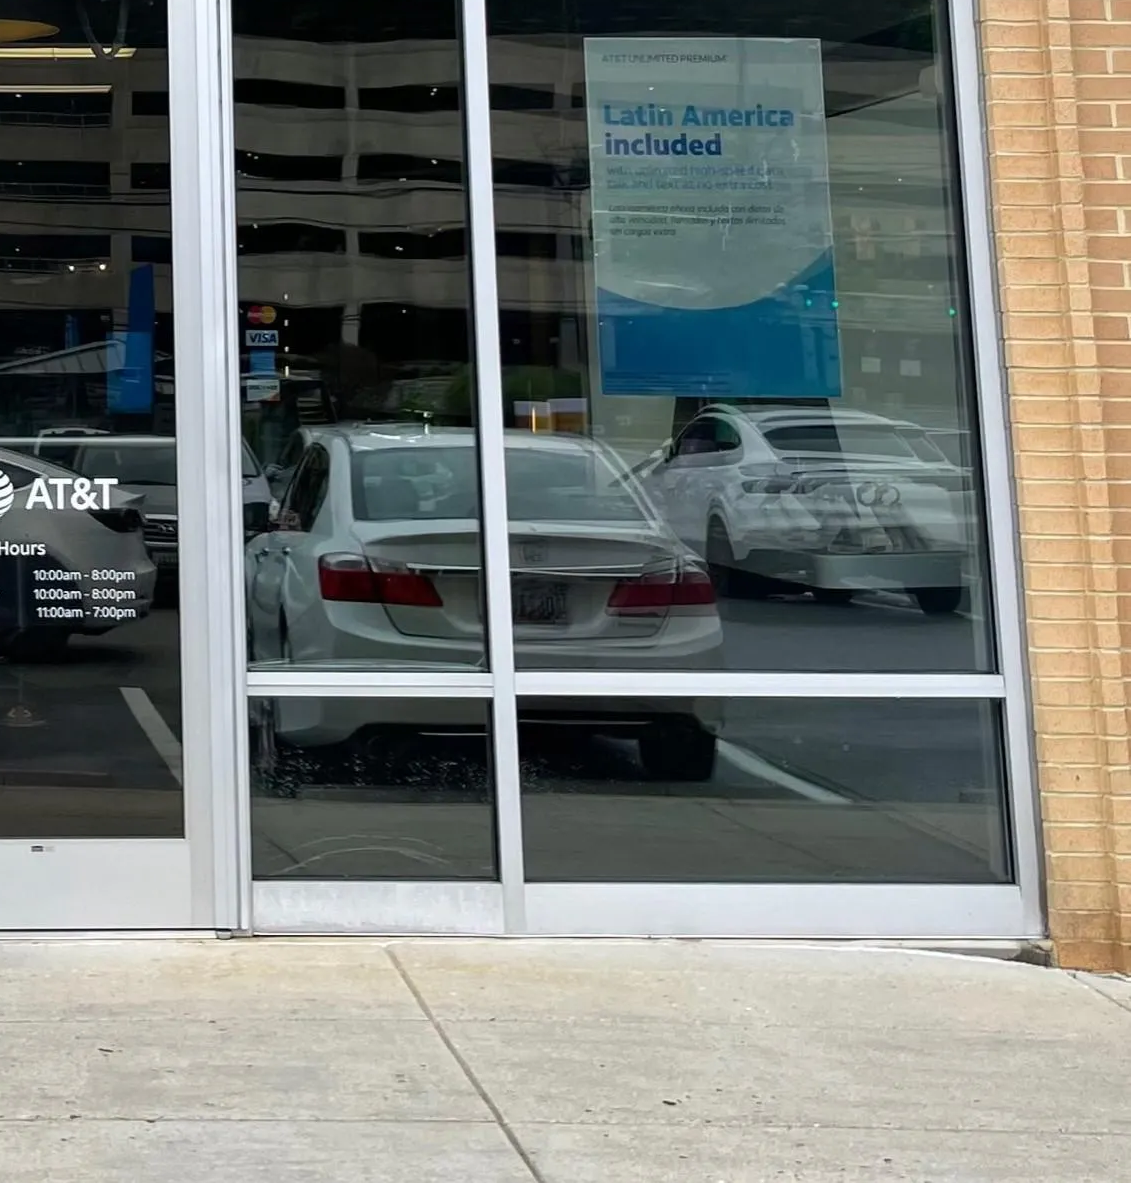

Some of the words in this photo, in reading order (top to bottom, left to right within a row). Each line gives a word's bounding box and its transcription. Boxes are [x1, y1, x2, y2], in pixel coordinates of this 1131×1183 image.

[603, 104, 674, 126] Latin
[681, 104, 795, 127] America
[605, 133, 722, 156] included
[249, 333, 277, 344] VISA
[25, 477, 118, 511] AT&T
[33, 570, 82, 581] 10:00am
[91, 570, 135, 584] 8:00pm
[33, 589, 82, 600] 10:00am
[91, 589, 136, 603] 8:00pm
[36, 607, 83, 618] 11:00am
[93, 607, 136, 620] 7:00pm
